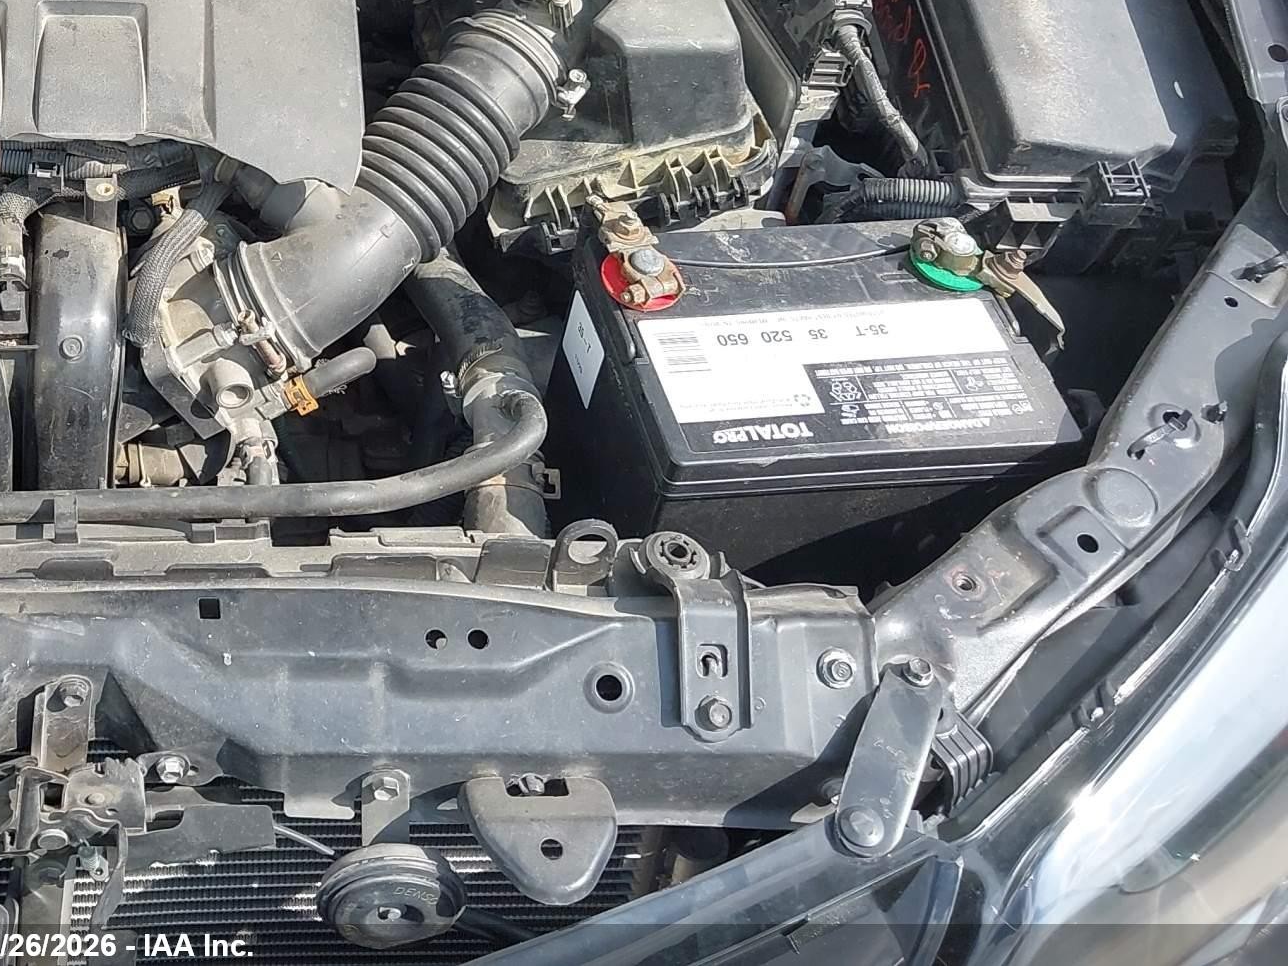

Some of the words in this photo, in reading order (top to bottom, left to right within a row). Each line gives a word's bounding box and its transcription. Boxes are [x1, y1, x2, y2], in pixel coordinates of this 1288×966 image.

[760, 329, 793, 344] 520
[808, 328, 829, 340] 35
[855, 324, 889, 337] 35-T
[716, 333, 749, 347] 650
[712, 421, 814, 444] TOTALPRO
